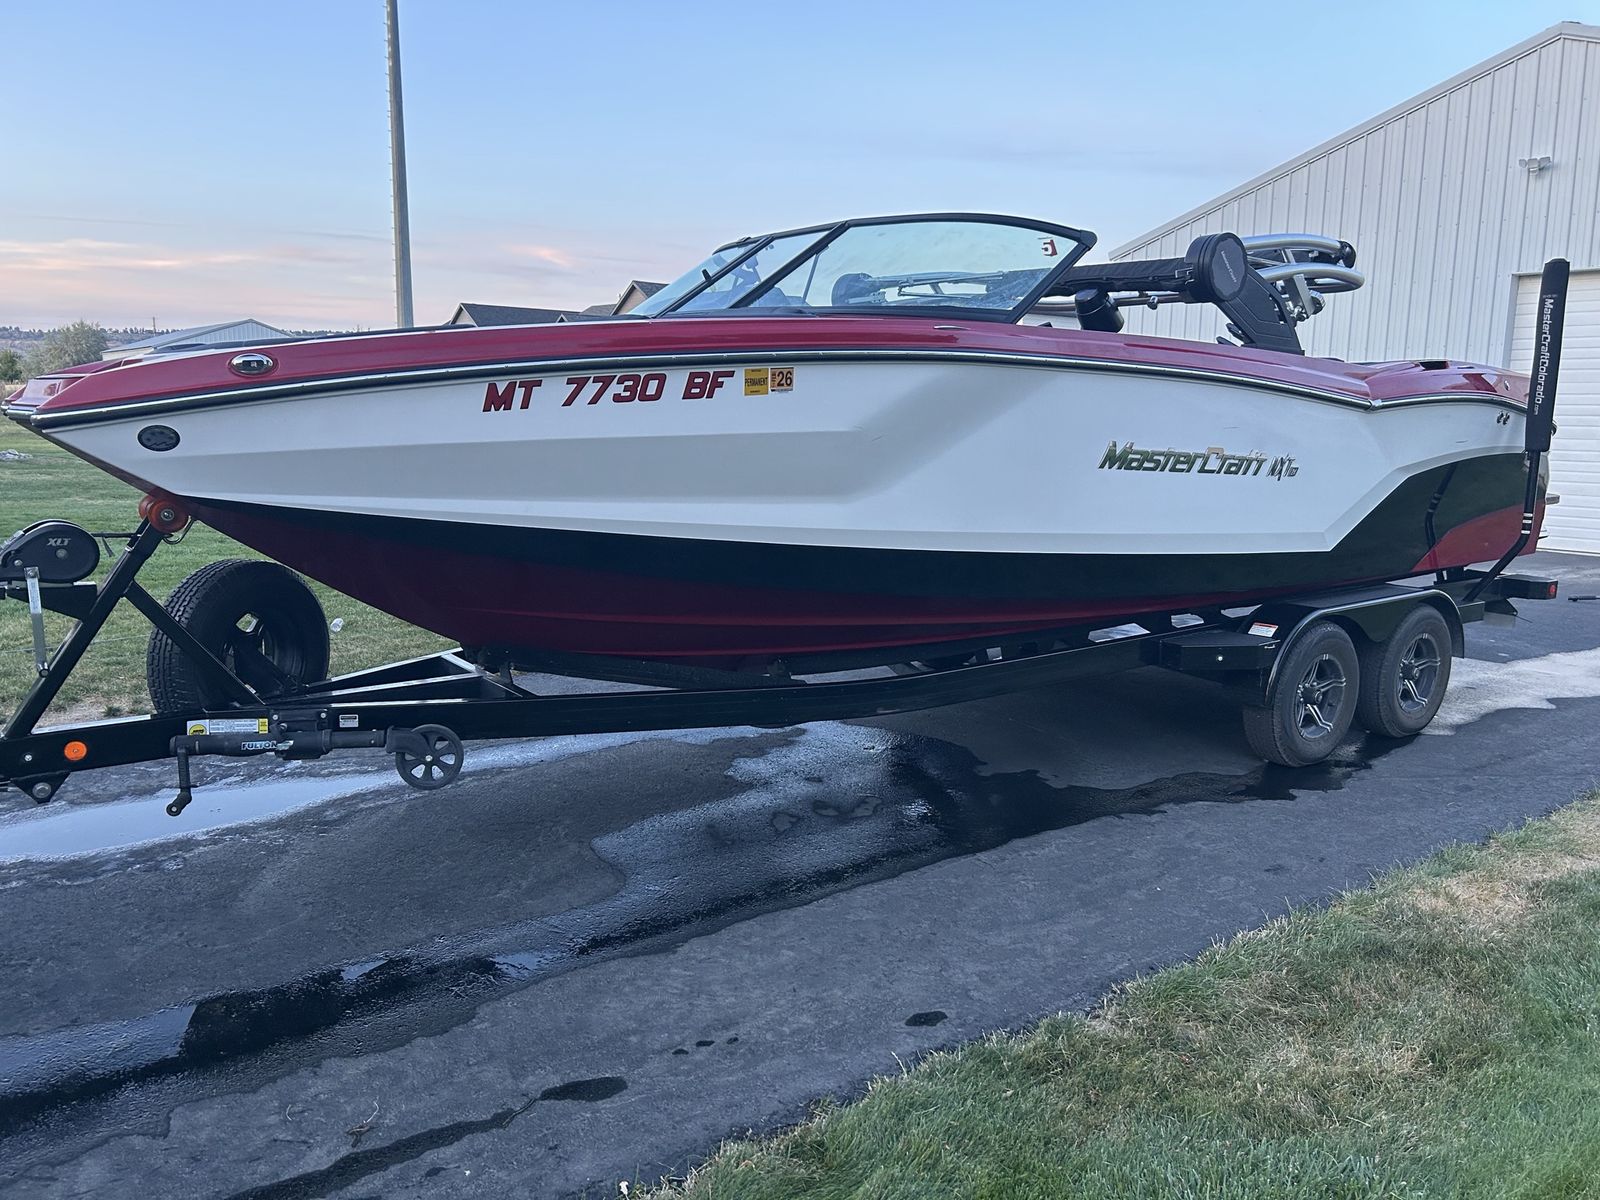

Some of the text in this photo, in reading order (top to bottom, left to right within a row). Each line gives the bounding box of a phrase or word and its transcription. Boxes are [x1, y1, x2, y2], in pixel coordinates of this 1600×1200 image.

[776, 371, 793, 387] 26
[482, 379, 543, 412] MT
[561, 373, 667, 407] 7730
[681, 370, 736, 400] BF
[1098, 440, 1268, 477] MasterCraft
[46, 537, 72, 547] XLT
[241, 740, 278, 751] FULTON
